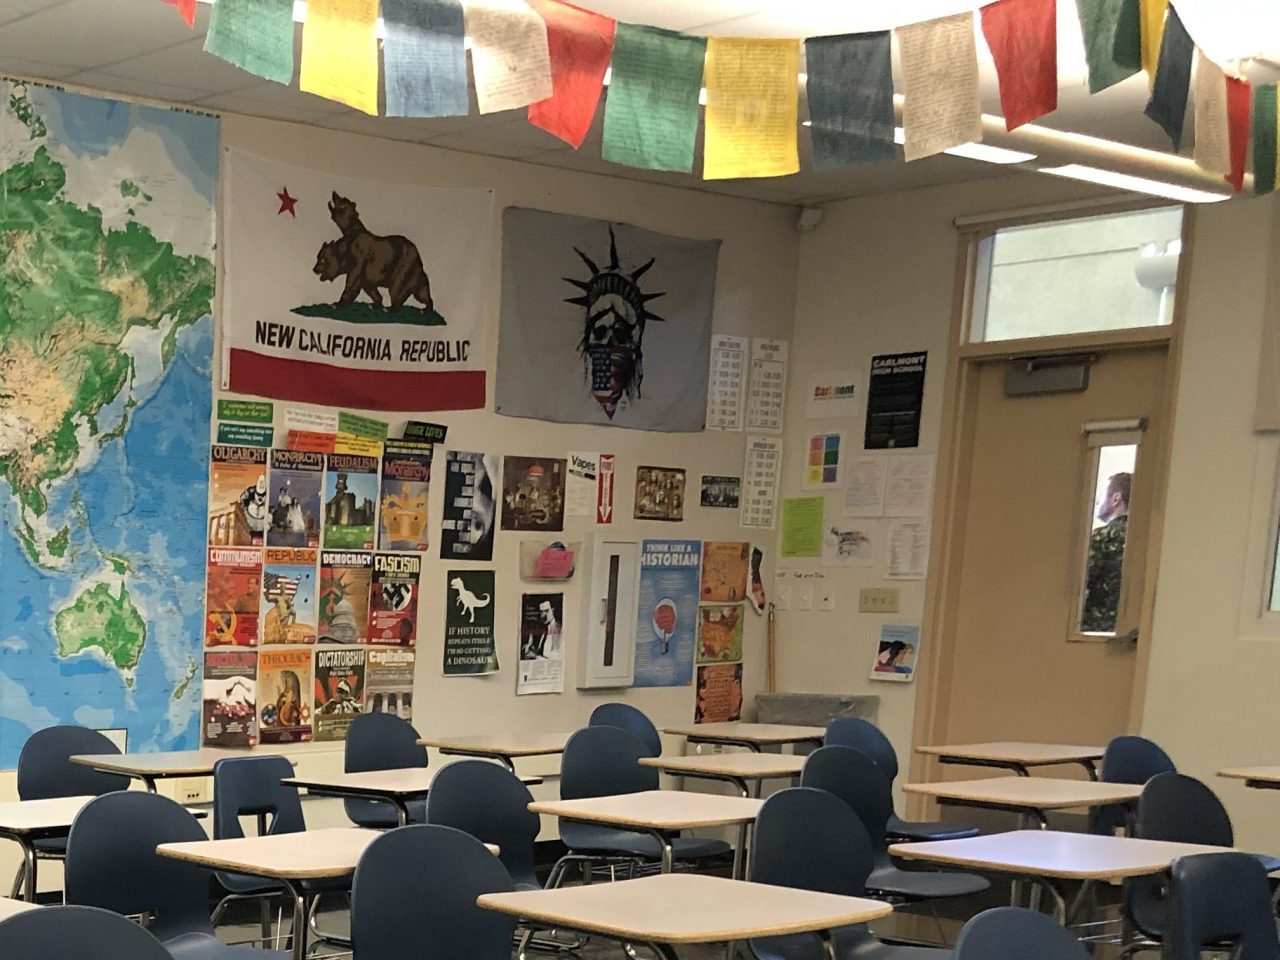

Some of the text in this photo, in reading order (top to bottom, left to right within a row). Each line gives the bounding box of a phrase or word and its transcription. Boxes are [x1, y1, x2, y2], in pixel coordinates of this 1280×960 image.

[255, 320, 471, 362] NEW CALIFORNIA REPUBLIC
[872, 355, 926, 368] CARLMONT
[893, 365, 924, 373] SCHOOL
[214, 446, 265, 461] OLIGARCHY
[273, 450, 322, 465] MONARCHY
[330, 456, 378, 469] FEUDALISM
[571, 454, 596, 472] Vapes
[646, 544, 669, 552] THINK
[670, 544, 685, 552] LIKE
[267, 549, 317, 562] REPUBLIC
[323, 553, 371, 565] DEMOCRACY
[640, 553, 698, 566] HISTORIAN
[448, 626, 490, 636] IF HISTORY
[318, 650, 365, 668] DICTATORSHIP
[369, 650, 415, 666] Capitalism
[453, 656, 493, 665] DINOSAUR
